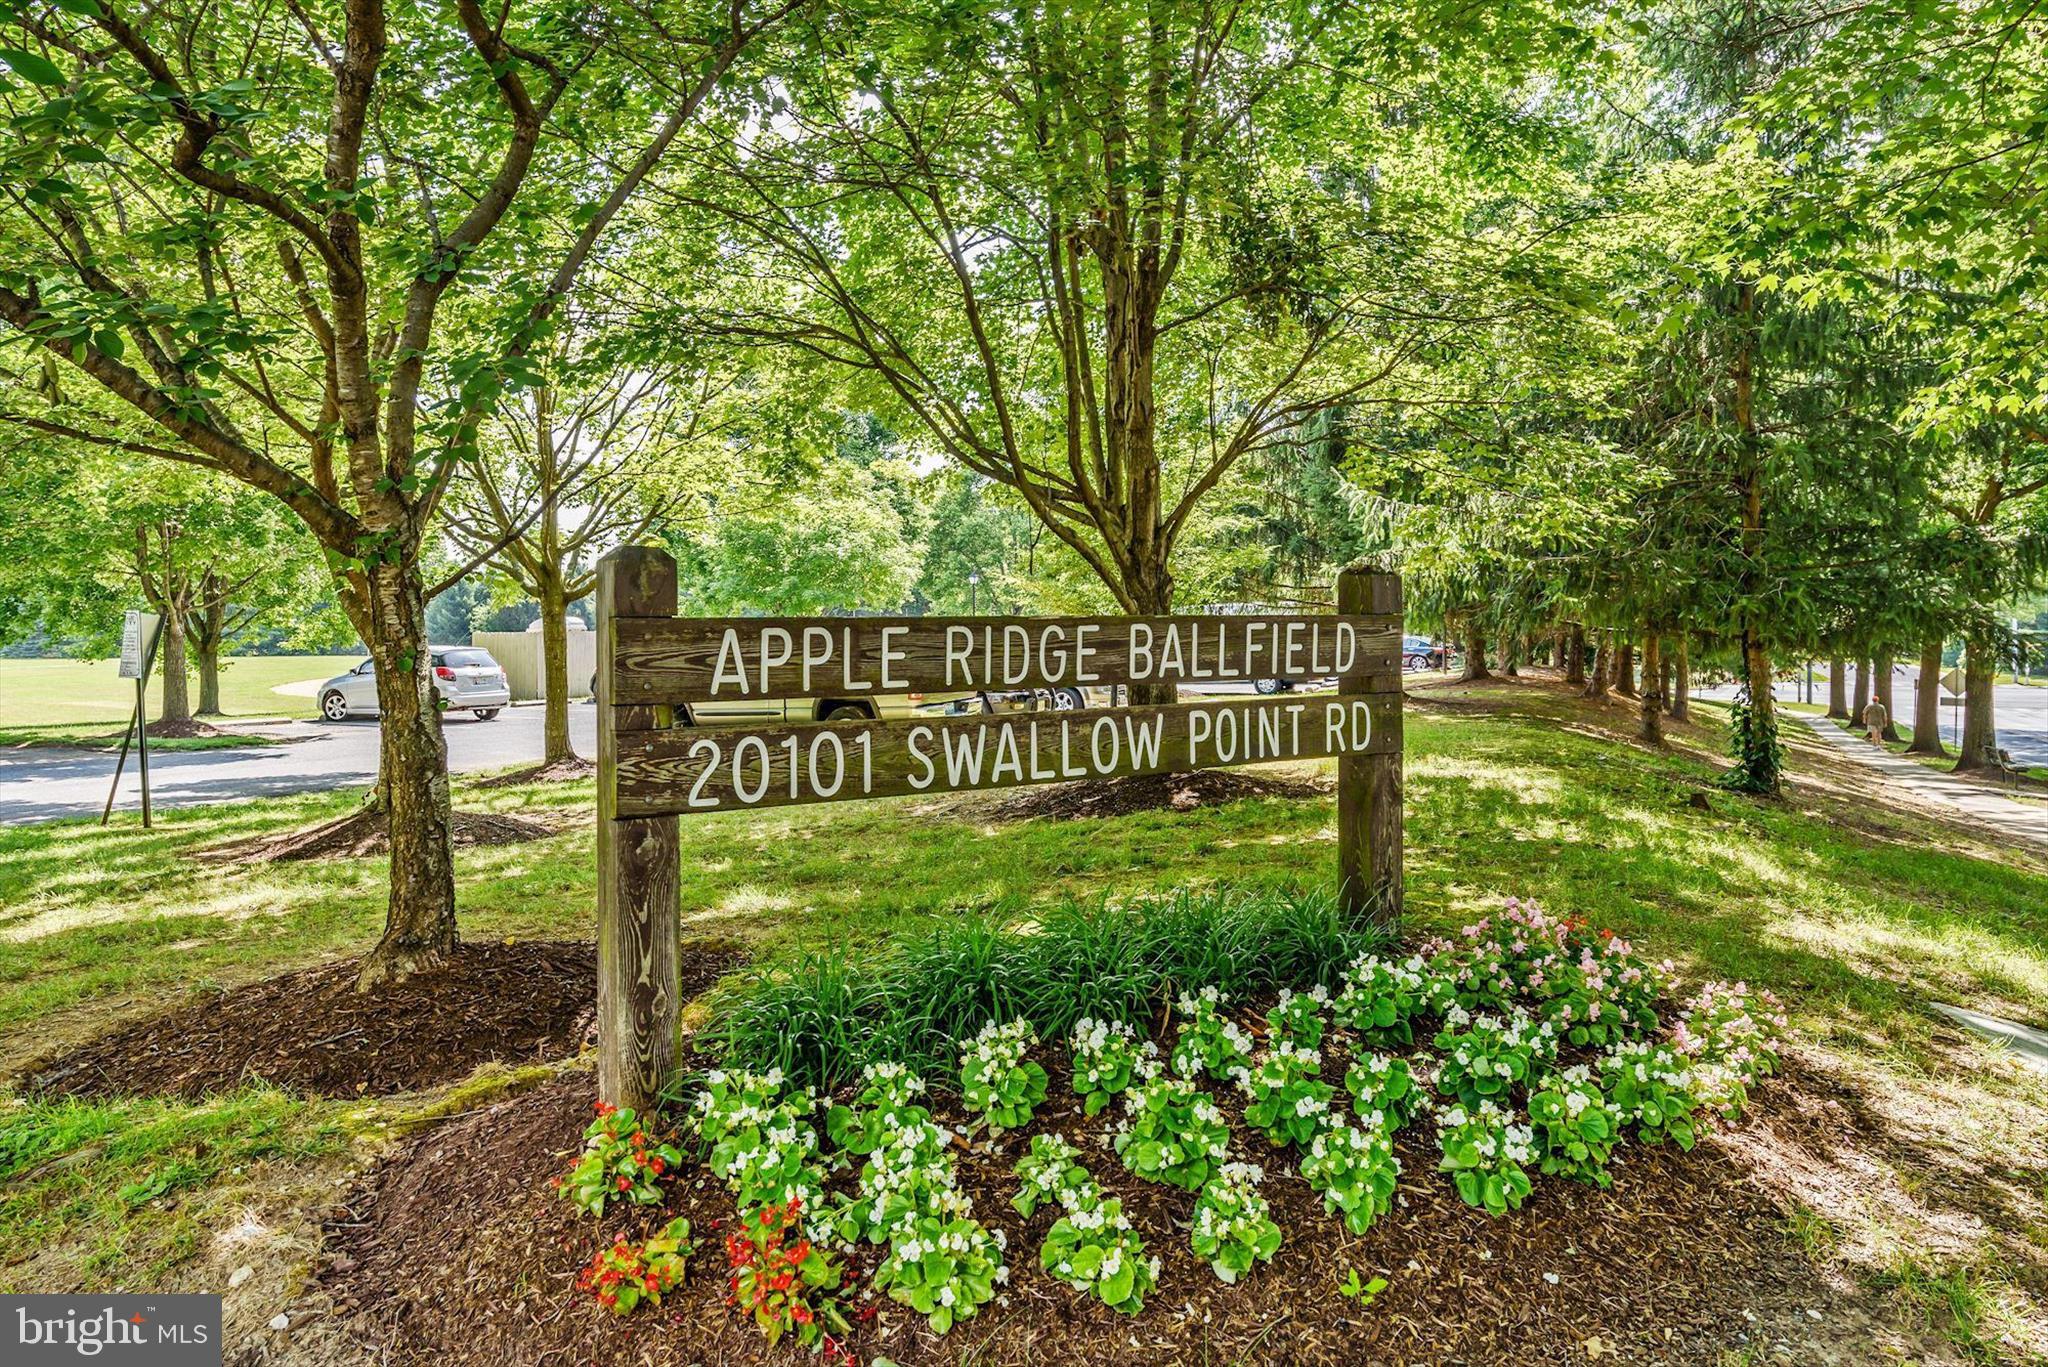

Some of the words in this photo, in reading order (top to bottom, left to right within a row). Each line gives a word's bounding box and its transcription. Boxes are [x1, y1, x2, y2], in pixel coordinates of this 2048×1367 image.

[710, 627, 910, 695] APPLE
[945, 624, 1100, 686] RIDGE
[1129, 622, 1356, 680] BALLFIELD
[687, 730, 872, 807] 20101
[907, 713, 1164, 790] SWALLOW
[1189, 704, 1306, 765] POINT
[1326, 701, 1371, 753] RD
